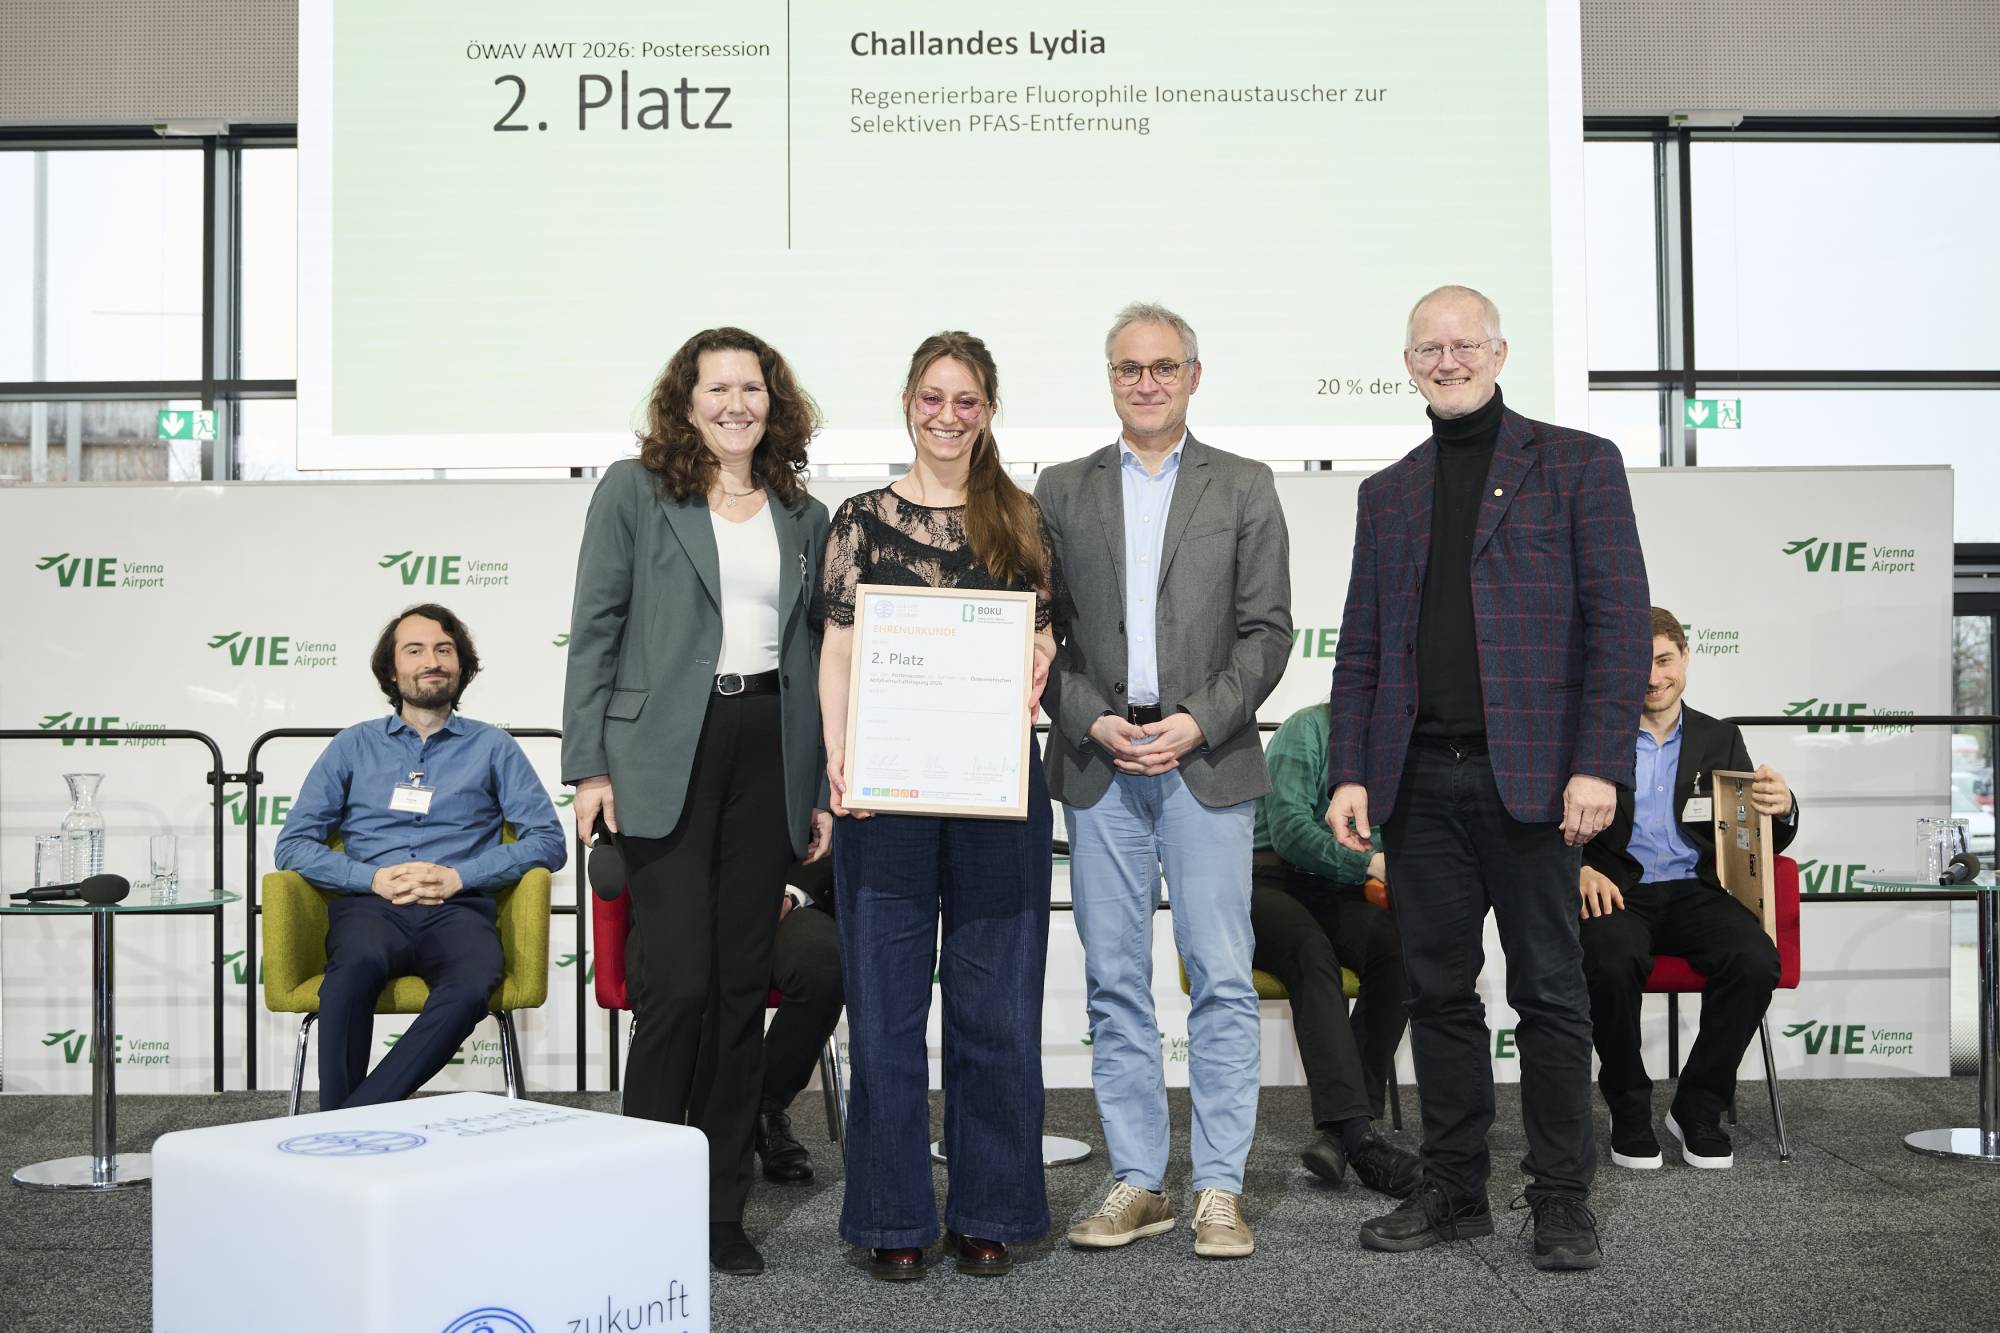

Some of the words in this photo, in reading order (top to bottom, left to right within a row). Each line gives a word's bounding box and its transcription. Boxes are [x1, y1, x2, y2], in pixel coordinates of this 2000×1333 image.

[466, 40, 527, 60] ÖWAV
[532, 42, 577, 59] AWT
[582, 40, 636, 59] 2026:
[642, 40, 770, 58] Postersession
[850, 30, 1018, 56] Challandes
[1030, 29, 1105, 61] Lydia
[493, 74, 548, 132] 2.
[578, 69, 733, 132] Platz
[850, 86, 1018, 110] Regenerierbare
[1025, 84, 1148, 108] Fluorophile
[1156, 83, 1348, 105] Ionenaustauscher
[1354, 87, 1388, 103] zur
[850, 113, 961, 134] Selektiven
[970, 111, 1151, 136] PFAS-Entfernung
[1317, 377, 1341, 395] 20
[1346, 377, 1364, 396] %
[1370, 377, 1402, 395] der
[1408, 378, 1418, 395] S
[1805, 542, 1867, 573] VIE
[1873, 546, 1915, 558] Vienna
[57, 558, 117, 588] VIE
[123, 562, 164, 574] Vienna
[400, 555, 461, 586] VIE
[467, 560, 509, 572] Vienna
[1871, 560, 1916, 574] Airport
[122, 576, 165, 590] Airport
[466, 573, 509, 588] Airport
[977, 606, 1002, 616] BOKU
[1697, 628, 1740, 640] Vienna
[230, 636, 289, 667] VIE
[295, 641, 337, 653] Vienna
[1695, 643, 1740, 656] Airport
[294, 655, 337, 669] Airport
[871, 652, 884, 665] 2.
[889, 652, 925, 666] Platz
[1804, 1024, 1865, 1054] VIE
[1872, 1029, 1913, 1041] Vienna
[129, 1039, 170, 1051] Vienna
[472, 1041, 502, 1052] Vien
[1870, 1043, 1913, 1057] Airport
[127, 1053, 170, 1067] Airport
[470, 1054, 502, 1068] Airpo
